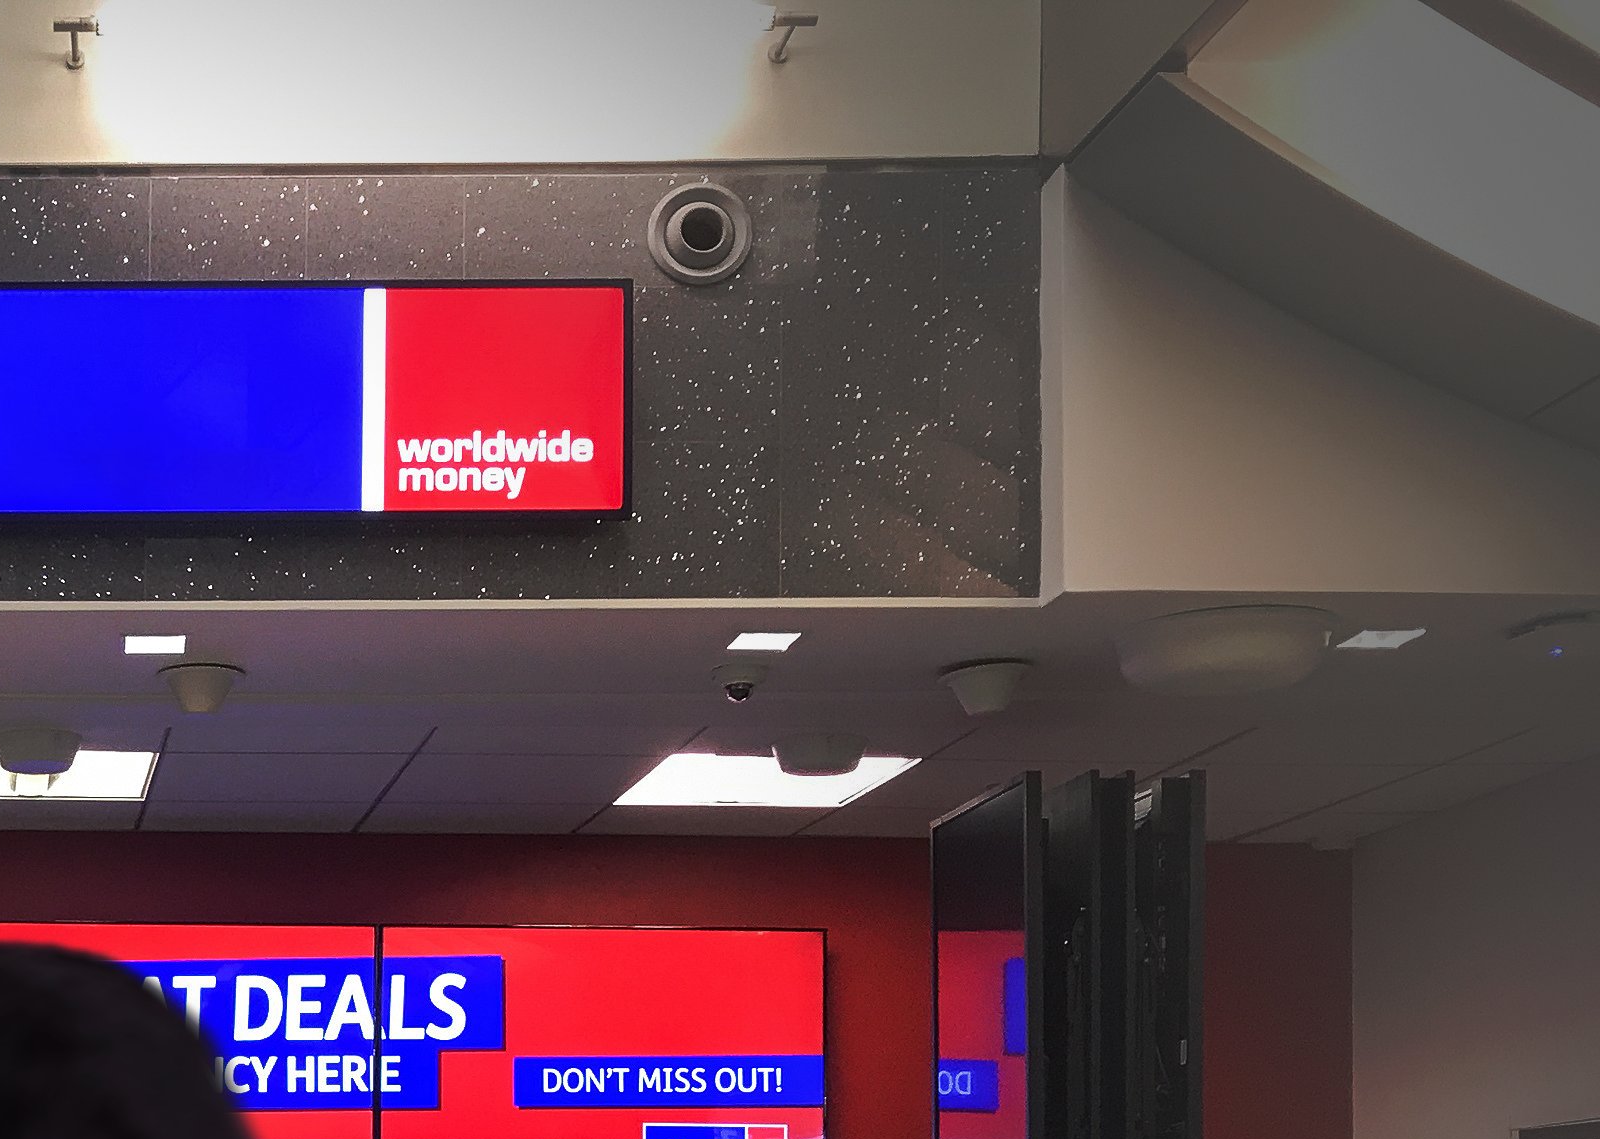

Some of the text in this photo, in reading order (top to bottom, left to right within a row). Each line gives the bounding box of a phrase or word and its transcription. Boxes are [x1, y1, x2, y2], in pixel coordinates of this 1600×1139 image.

[397, 429, 594, 463] worldwide
[398, 466, 527, 500] money
[233, 973, 467, 1042] DEALS
[287, 1055, 402, 1093] HERE
[542, 1067, 784, 1093] DON'T MISS OUT!
